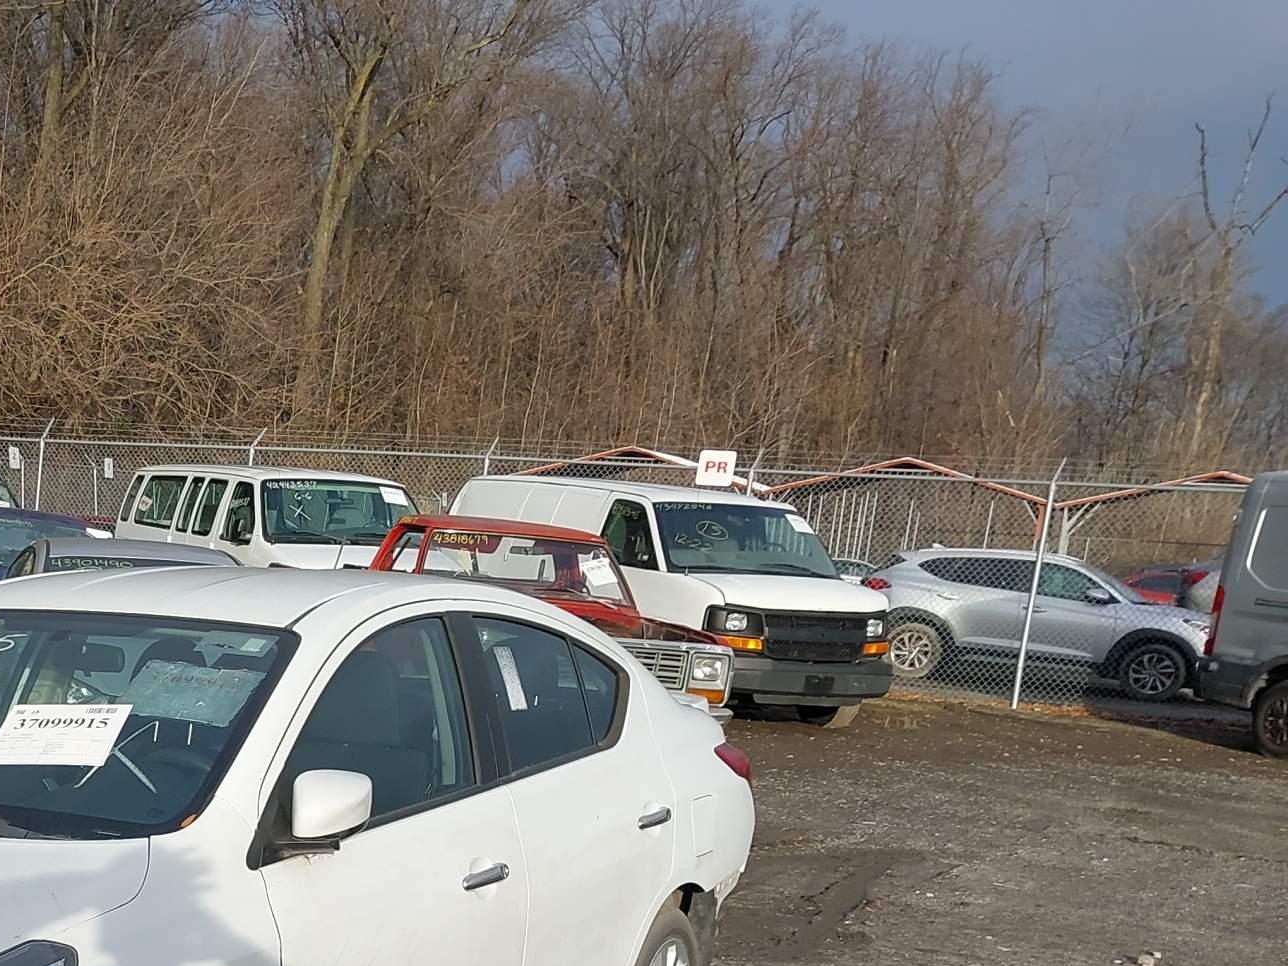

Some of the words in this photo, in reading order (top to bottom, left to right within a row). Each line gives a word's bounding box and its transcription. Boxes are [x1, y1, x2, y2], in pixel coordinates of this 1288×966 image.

[705, 461, 728, 473] PR
[433, 533, 489, 545] 43818679
[51, 559, 134, 569] 43901490
[13, 717, 112, 730] 37099915
